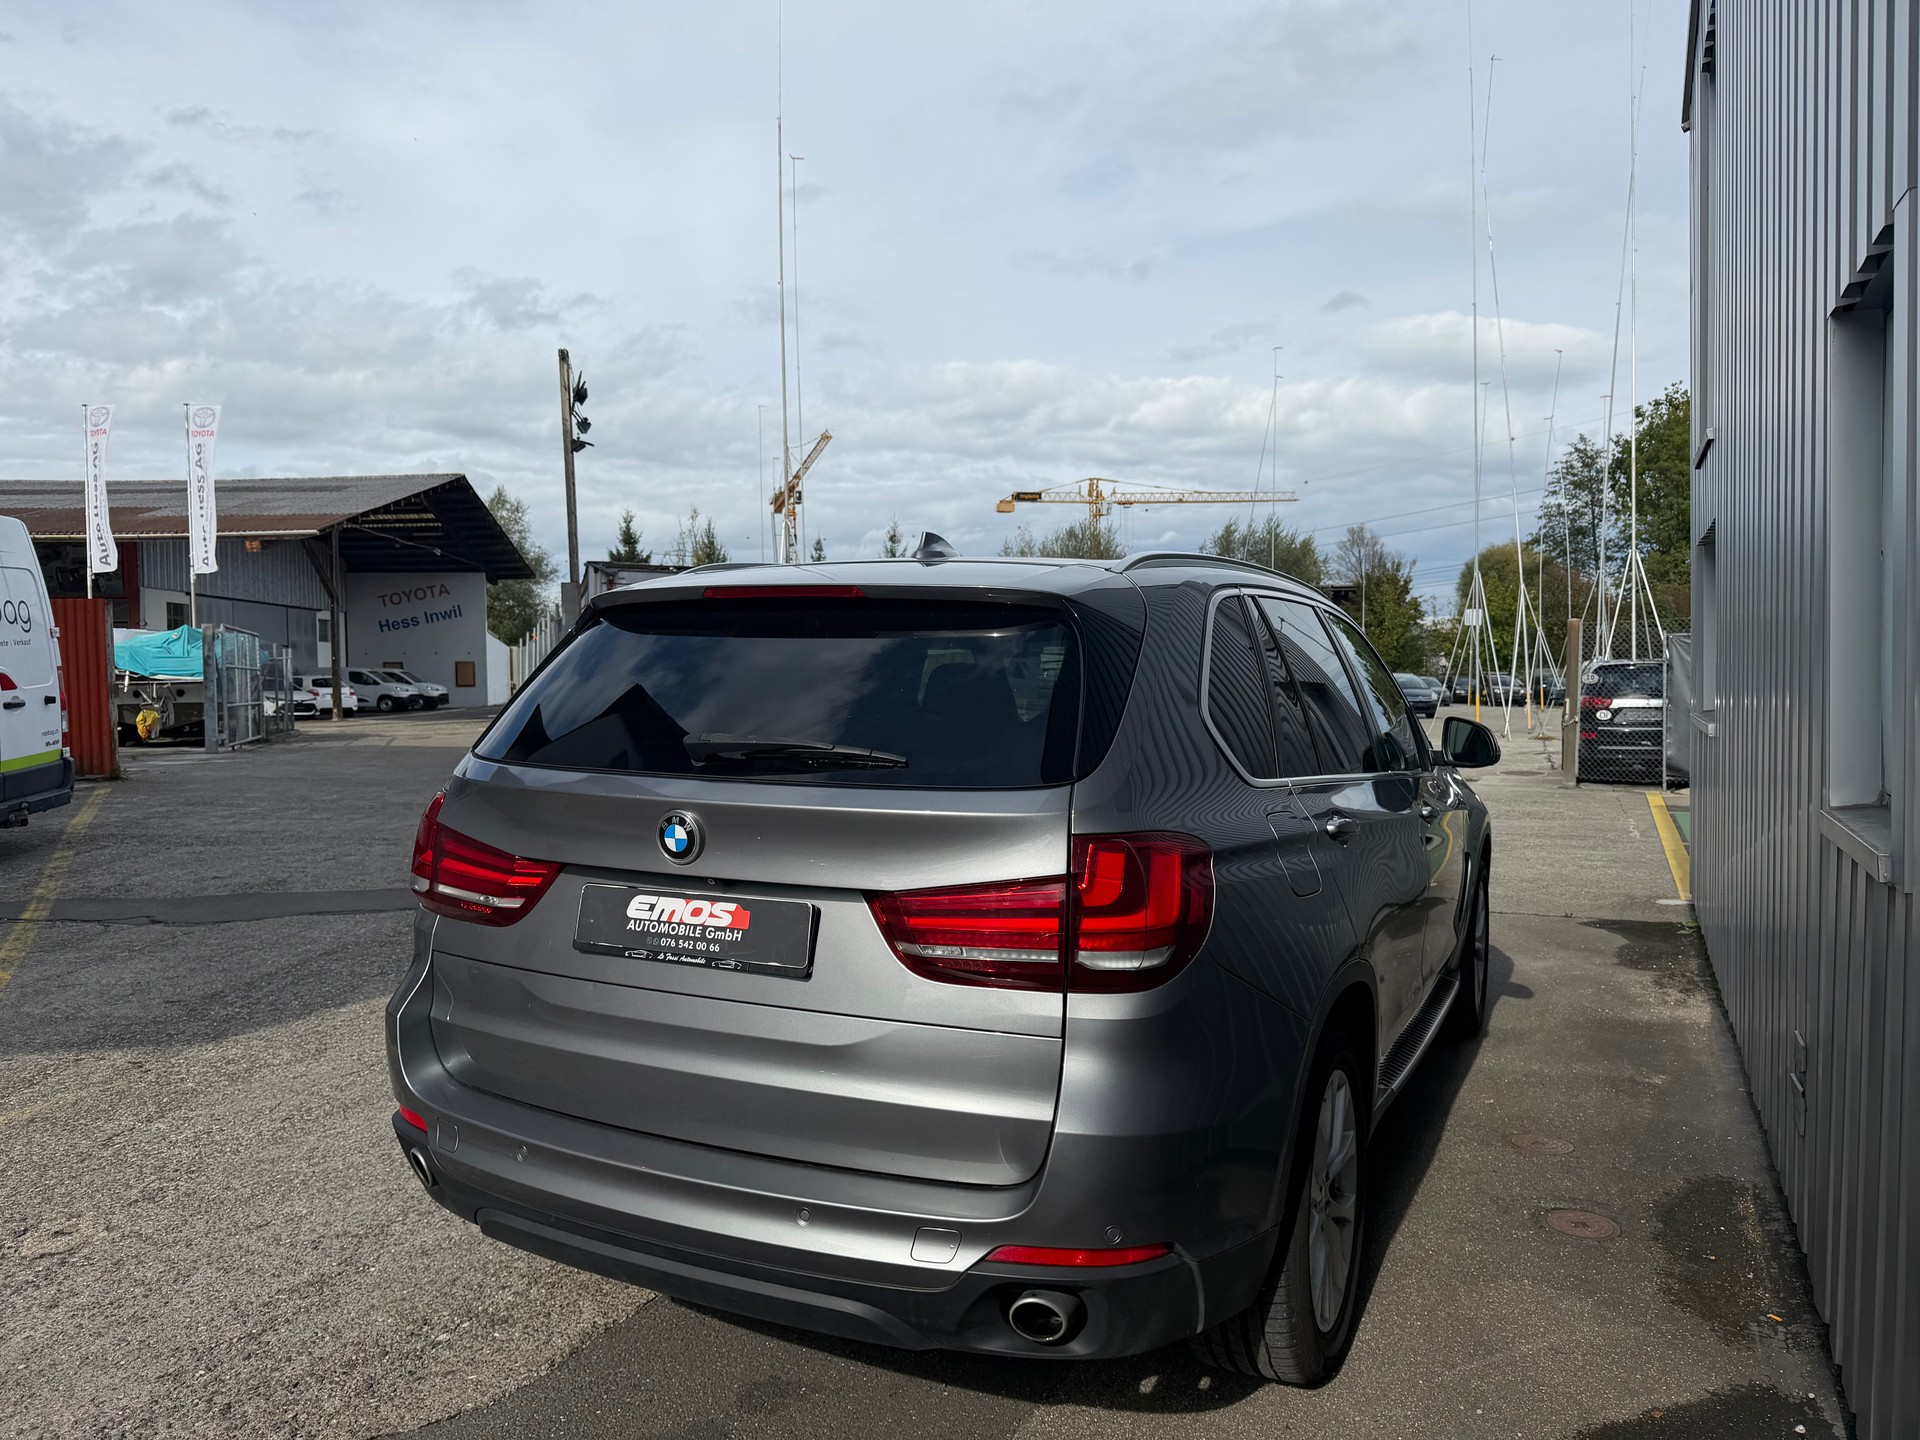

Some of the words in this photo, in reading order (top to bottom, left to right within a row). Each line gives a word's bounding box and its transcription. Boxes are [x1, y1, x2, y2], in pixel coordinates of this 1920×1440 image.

[195, 443, 204, 470] AG
[377, 583, 452, 608] TOYOTA
[0, 600, 31, 633] ag
[378, 615, 420, 633] Hess
[423, 604, 463, 624] Inwil
[661, 816, 693, 832] BMW
[626, 894, 738, 927] EMOS
[626, 920, 703, 938] AUTOMOBILE
[705, 927, 743, 941] GmbH
[660, 937, 676, 947] 076
[678, 939, 694, 949] 542
[695, 941, 707, 951] 00
[709, 942, 720, 952] 66
[679, 954, 706, 964] Automobile
